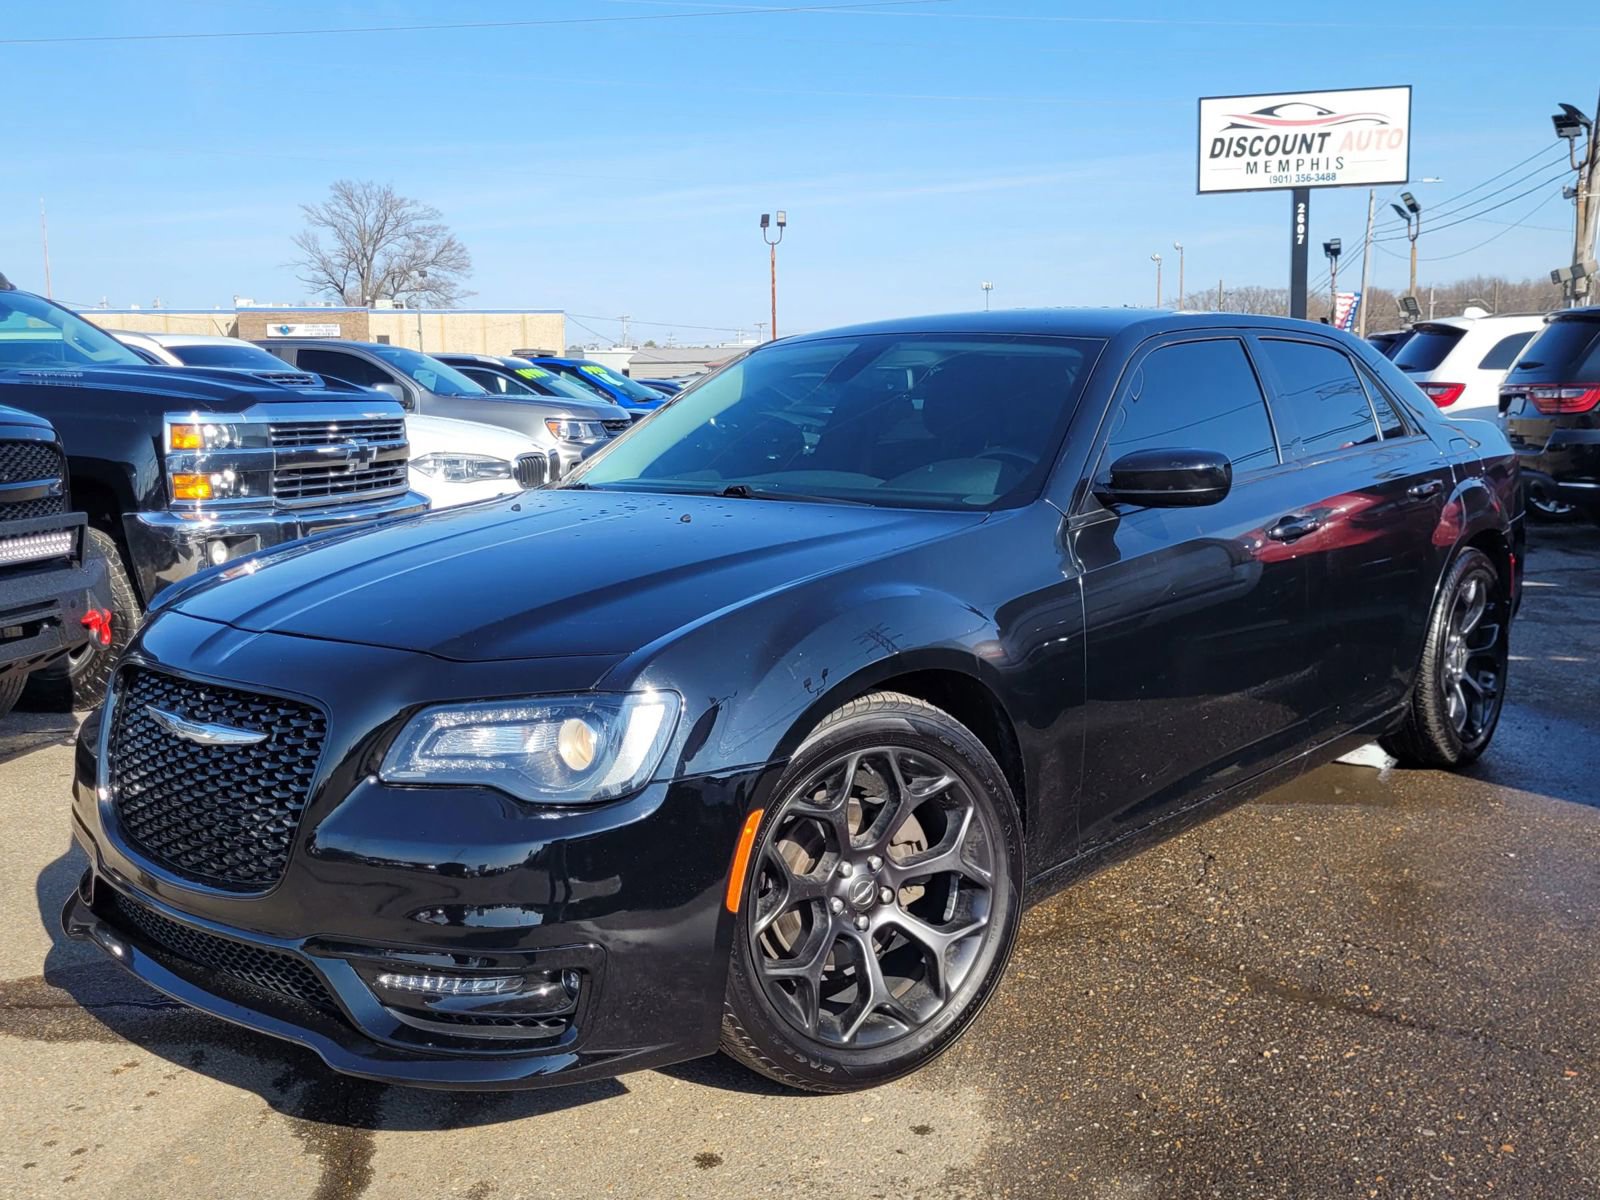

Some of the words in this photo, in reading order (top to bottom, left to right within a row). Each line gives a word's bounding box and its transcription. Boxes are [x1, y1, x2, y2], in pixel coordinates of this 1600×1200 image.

[1209, 132, 1331, 159] DISCOUNT
[1339, 128, 1404, 153] AUTO
[1245, 156, 1345, 175] MEMPHIS
[1269, 175, 1293, 185] (901)
[1295, 172, 1337, 183] 356-3488
[1296, 202, 1306, 245] 2607
